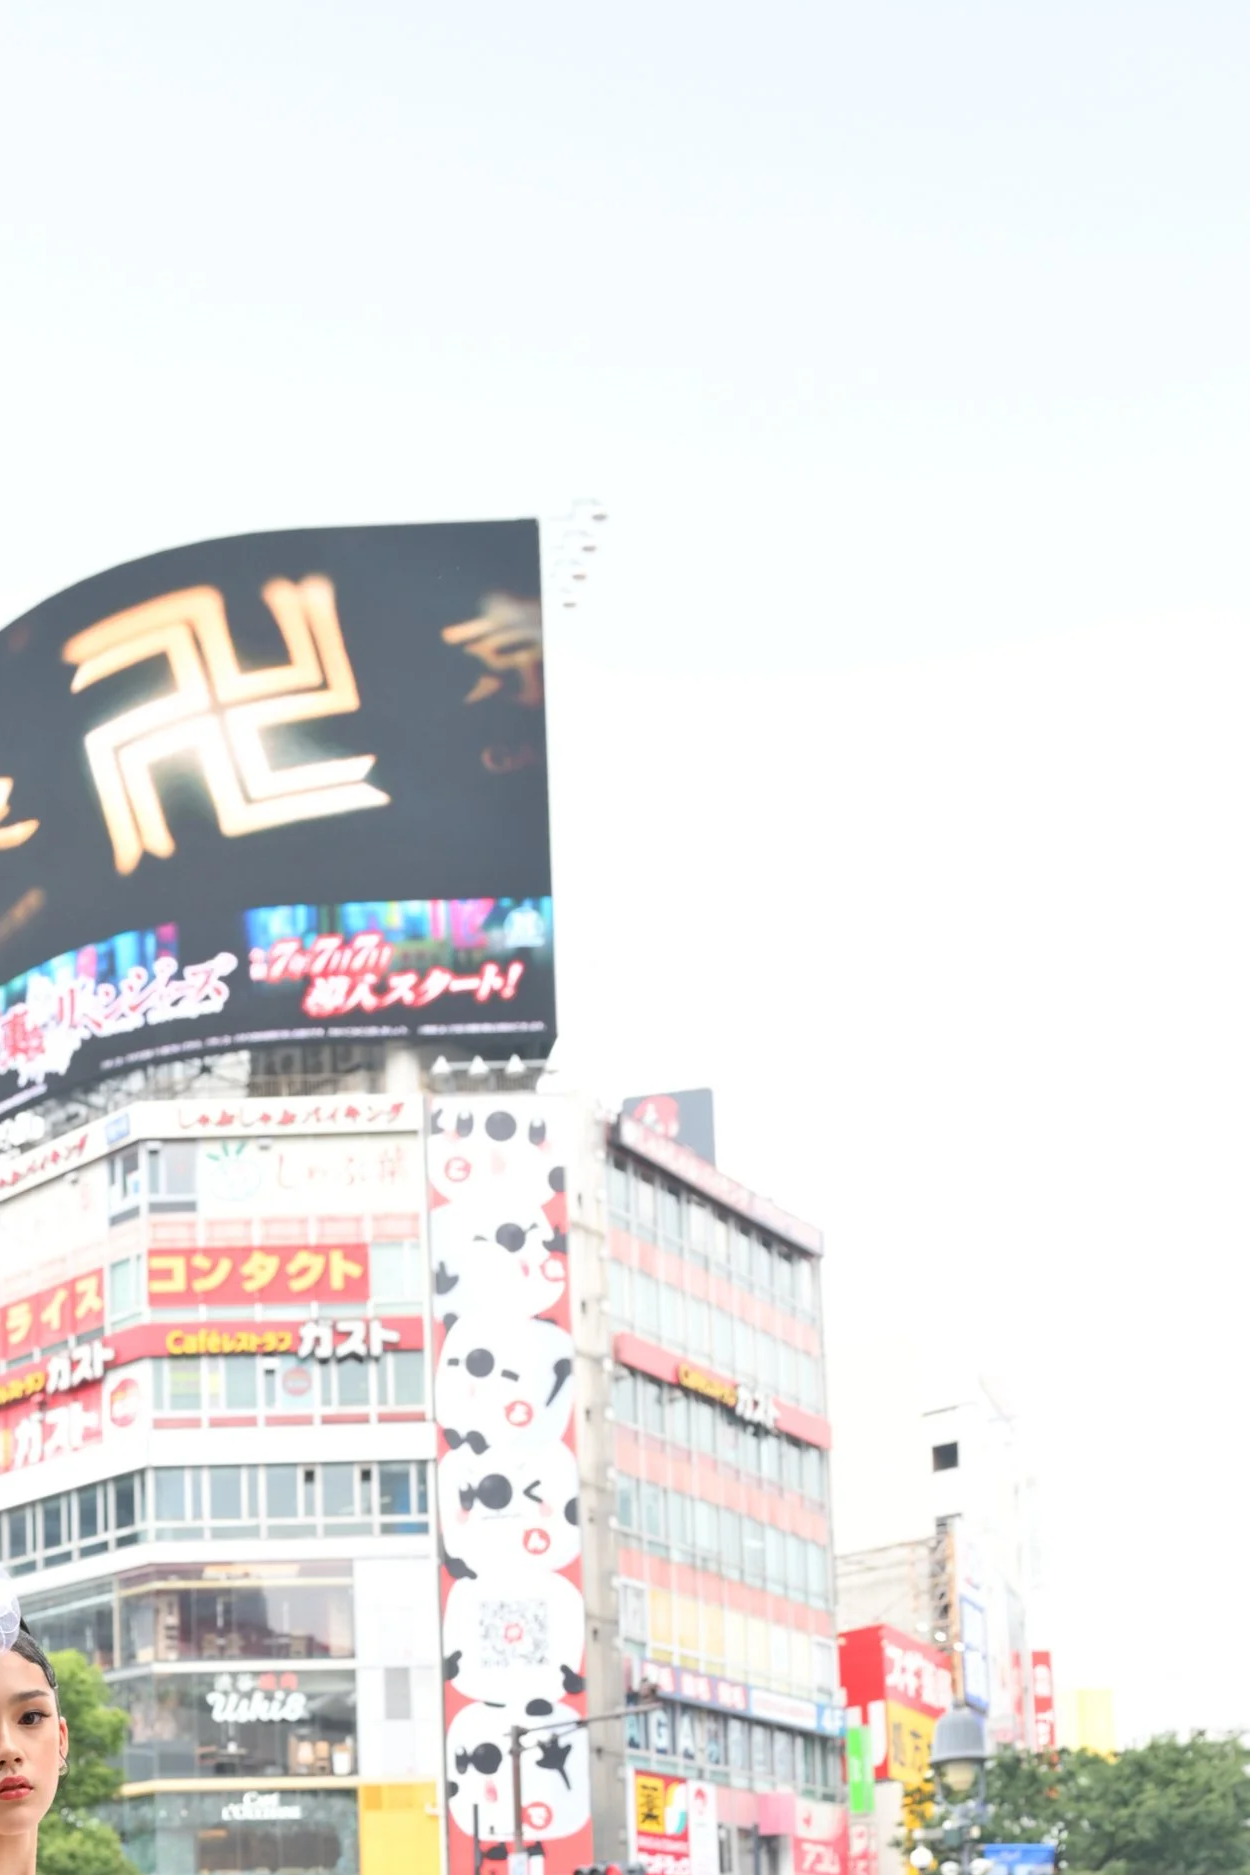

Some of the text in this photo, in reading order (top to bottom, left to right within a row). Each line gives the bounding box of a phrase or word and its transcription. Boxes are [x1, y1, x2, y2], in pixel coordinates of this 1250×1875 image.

[148, 1249, 364, 1292] コンタクト
[297, 1320, 401, 1360] ガスト
[46, 1340, 115, 1394] ガスト
[14, 1403, 99, 1470] ガスト
